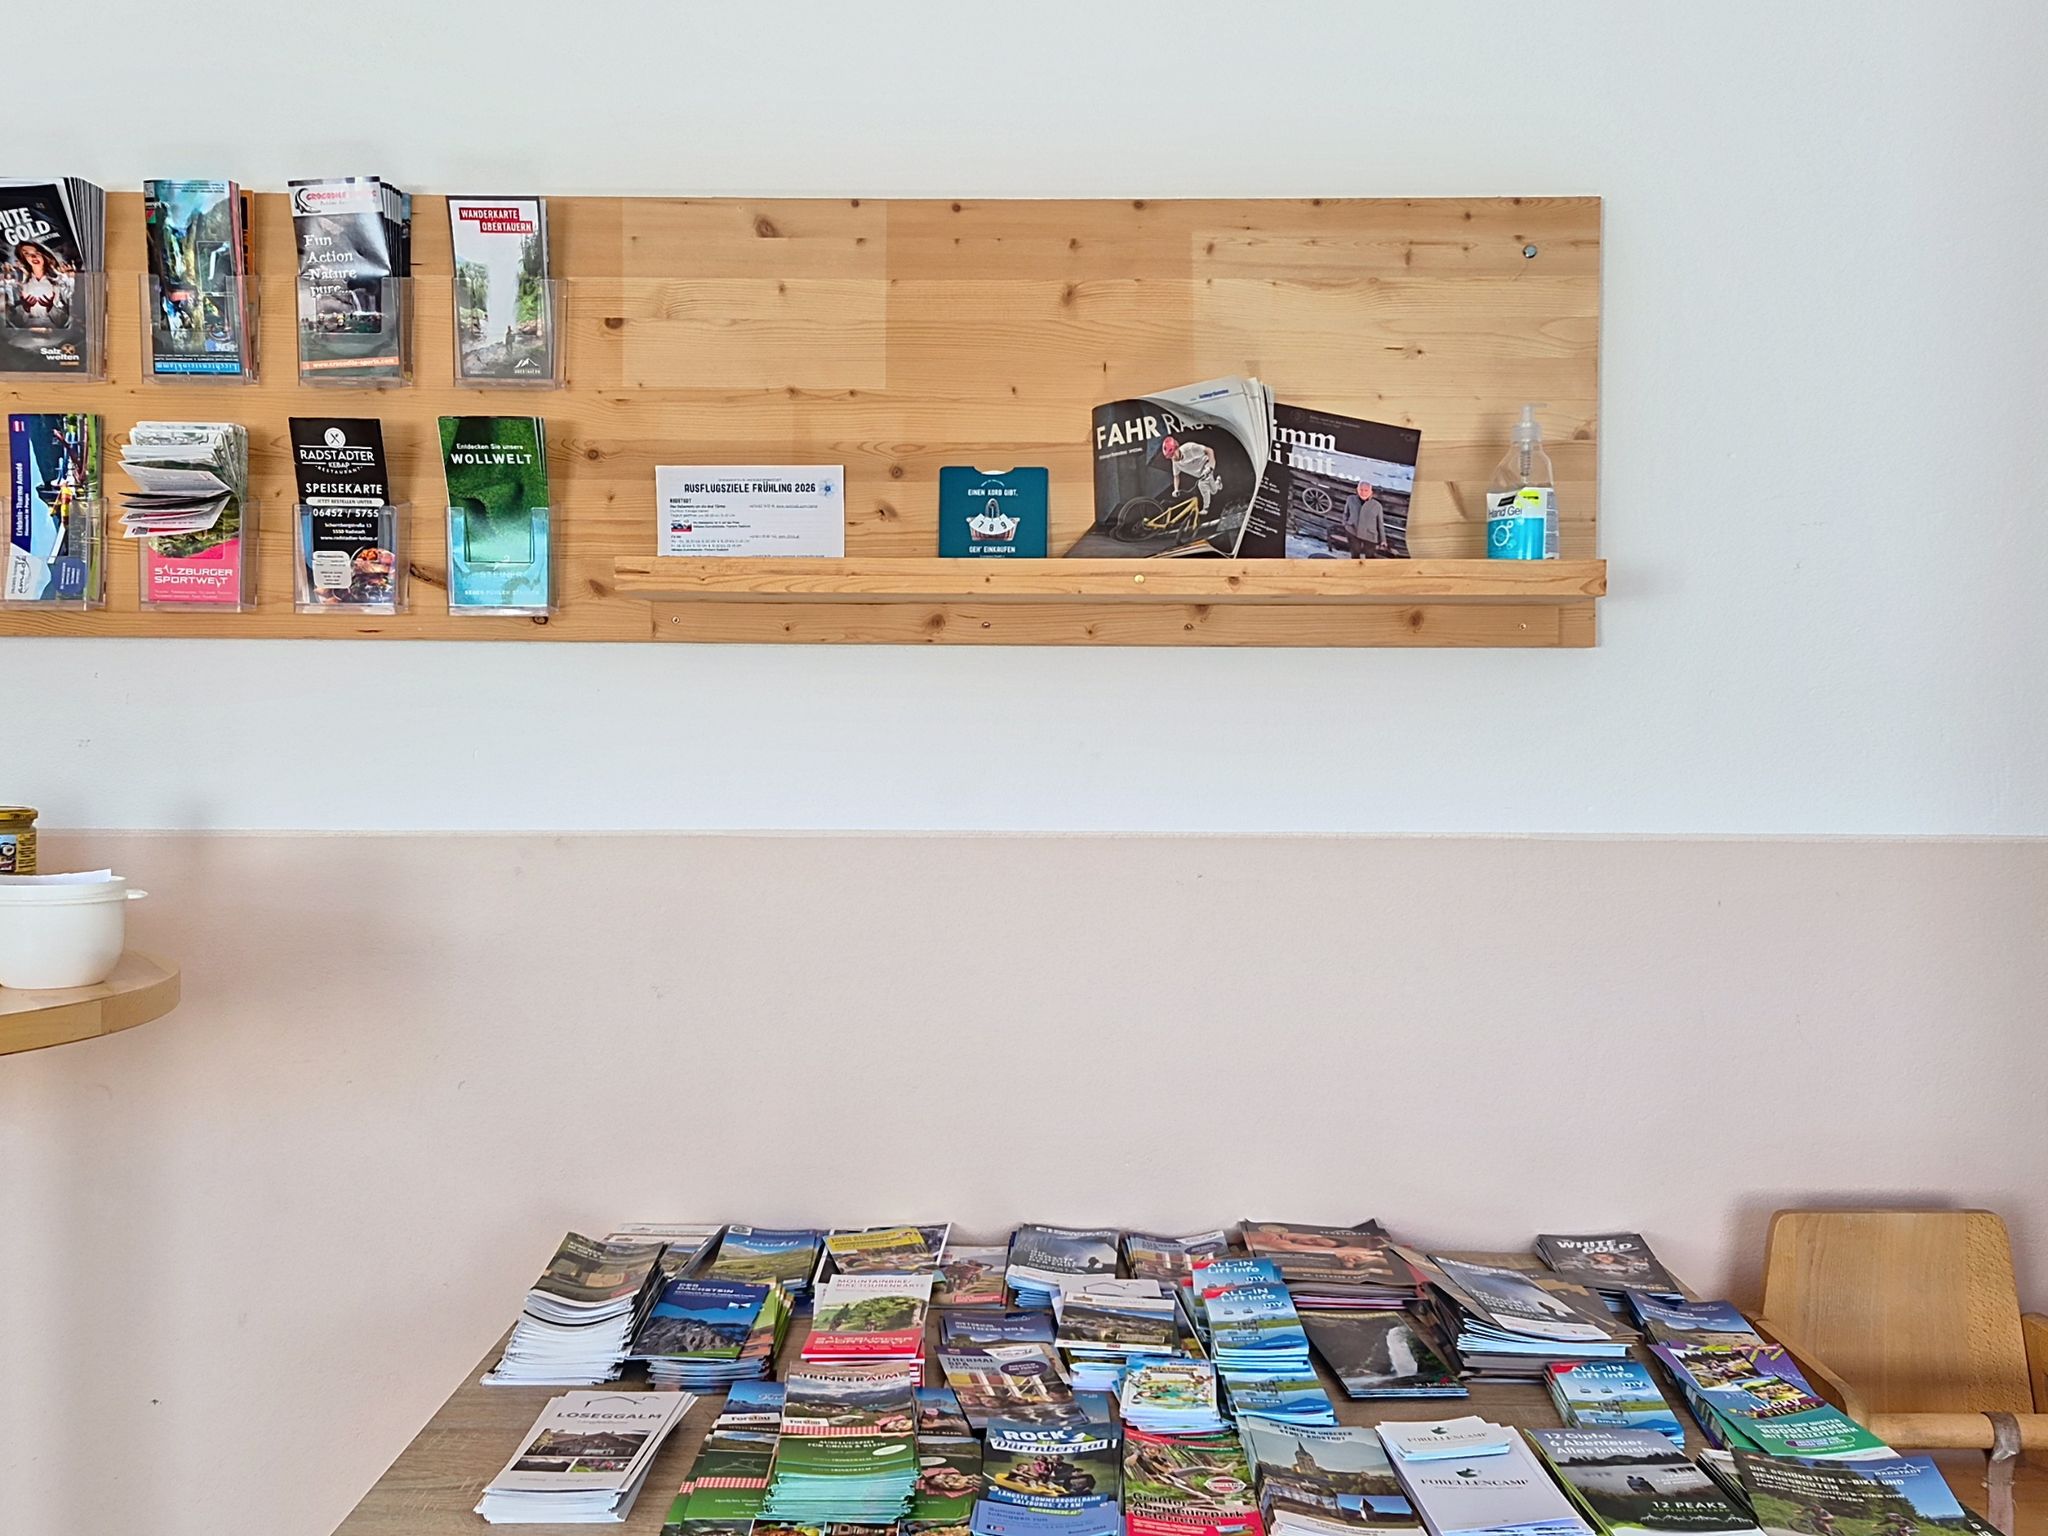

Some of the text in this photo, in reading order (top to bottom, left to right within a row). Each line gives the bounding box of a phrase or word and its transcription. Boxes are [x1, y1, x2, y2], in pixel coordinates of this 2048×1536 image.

[0, 207, 33, 230] HITE
[461, 208, 518, 220] WANDERKARTE
[482, 221, 532, 232] OBERTAUERN
[4, 220, 51, 246] GOLD
[304, 235, 332, 247] Fun
[307, 251, 353, 264] Action
[309, 267, 357, 280] Nature
[40, 347, 61, 355] Salz
[46, 353, 80, 361] welten
[1096, 416, 1161, 450] FAHR
[1273, 419, 1337, 452] imm
[450, 453, 533, 465] WOLLWELT
[305, 483, 383, 495] SPEISEKARTE
[684, 480, 816, 493] AUSFLUGSZIELE FRÜHLING 2026
[313, 508, 343, 517] 06452
[355, 509, 380, 518] 5755
[1507, 505, 1523, 516] Gel
[978, 520, 1008, 532] 7 8 9
[154, 565, 233, 576] SALZBURGER
[154, 576, 228, 588] SPORTWELT
[1556, 1239, 1617, 1248] WHITE
[1582, 1243, 1632, 1254] GOLD
[1207, 1260, 1254, 1268] ALL-IN
[1220, 1288, 1269, 1296] ALL-IN
[1571, 1365, 1625, 1373] ALL-IN
[1749, 1398, 1802, 1412] LUCKY
[557, 1412, 662, 1420] LOSEGGALM
[1002, 1430, 1068, 1440] ROCK
[1407, 1433, 1488, 1442] FORELLENCAMP
[1565, 1432, 1617, 1441] Gipfel.
[1783, 1426, 1859, 1439] FREIZEITPARK
[1557, 1447, 1597, 1455] Alles
[1749, 1464, 1905, 1486] DIE SCHÖNSTEN E-BIKE UND
[1874, 1468, 1922, 1476] RADSTADT
[1421, 1479, 1529, 1487] FORELLENCAMP
[1751, 1471, 1840, 1491] GENUSSROUTEN
[998, 1490, 1029, 1500] LÄNGSTE
[1133, 1501, 1245, 1518] Abenteuerpark
[1652, 1501, 1728, 1509] 12 PEAKS
